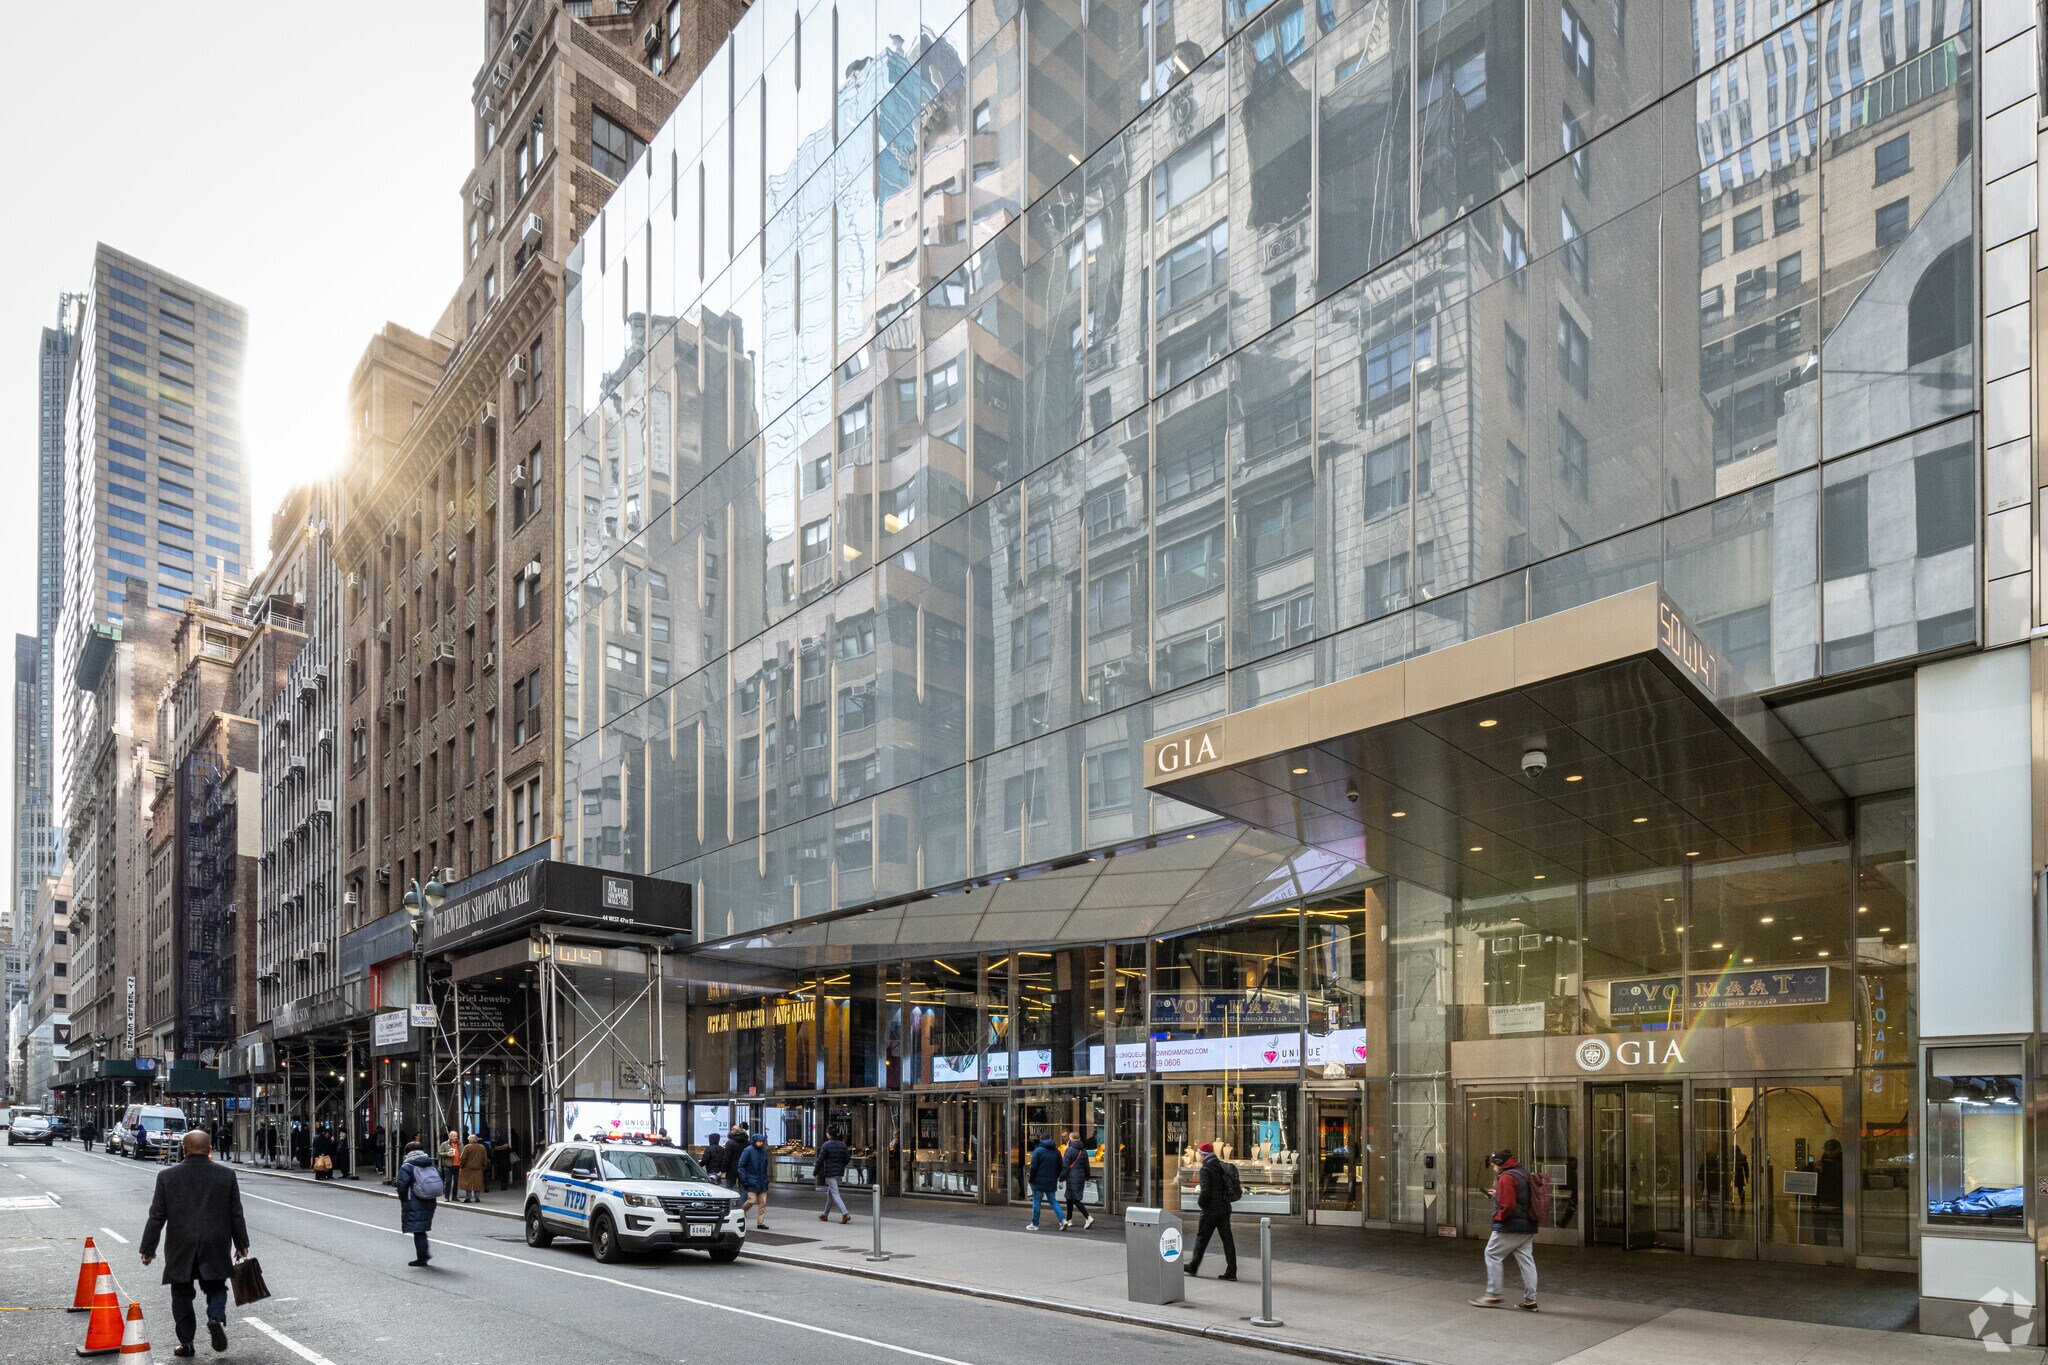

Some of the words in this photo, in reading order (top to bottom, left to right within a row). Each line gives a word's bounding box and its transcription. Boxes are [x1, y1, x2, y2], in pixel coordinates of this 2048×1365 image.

[1158, 733, 1218, 772] GIA
[443, 899, 471, 935] JEWELRY
[471, 884, 507, 923] SHOPPING
[508, 875, 530, 909] MALL
[479, 995, 511, 1005] Jewelry
[1281, 1047, 1321, 1058] UNIUE
[1616, 1039, 1687, 1066] GIA
[564, 1189, 587, 1211] NYPD
